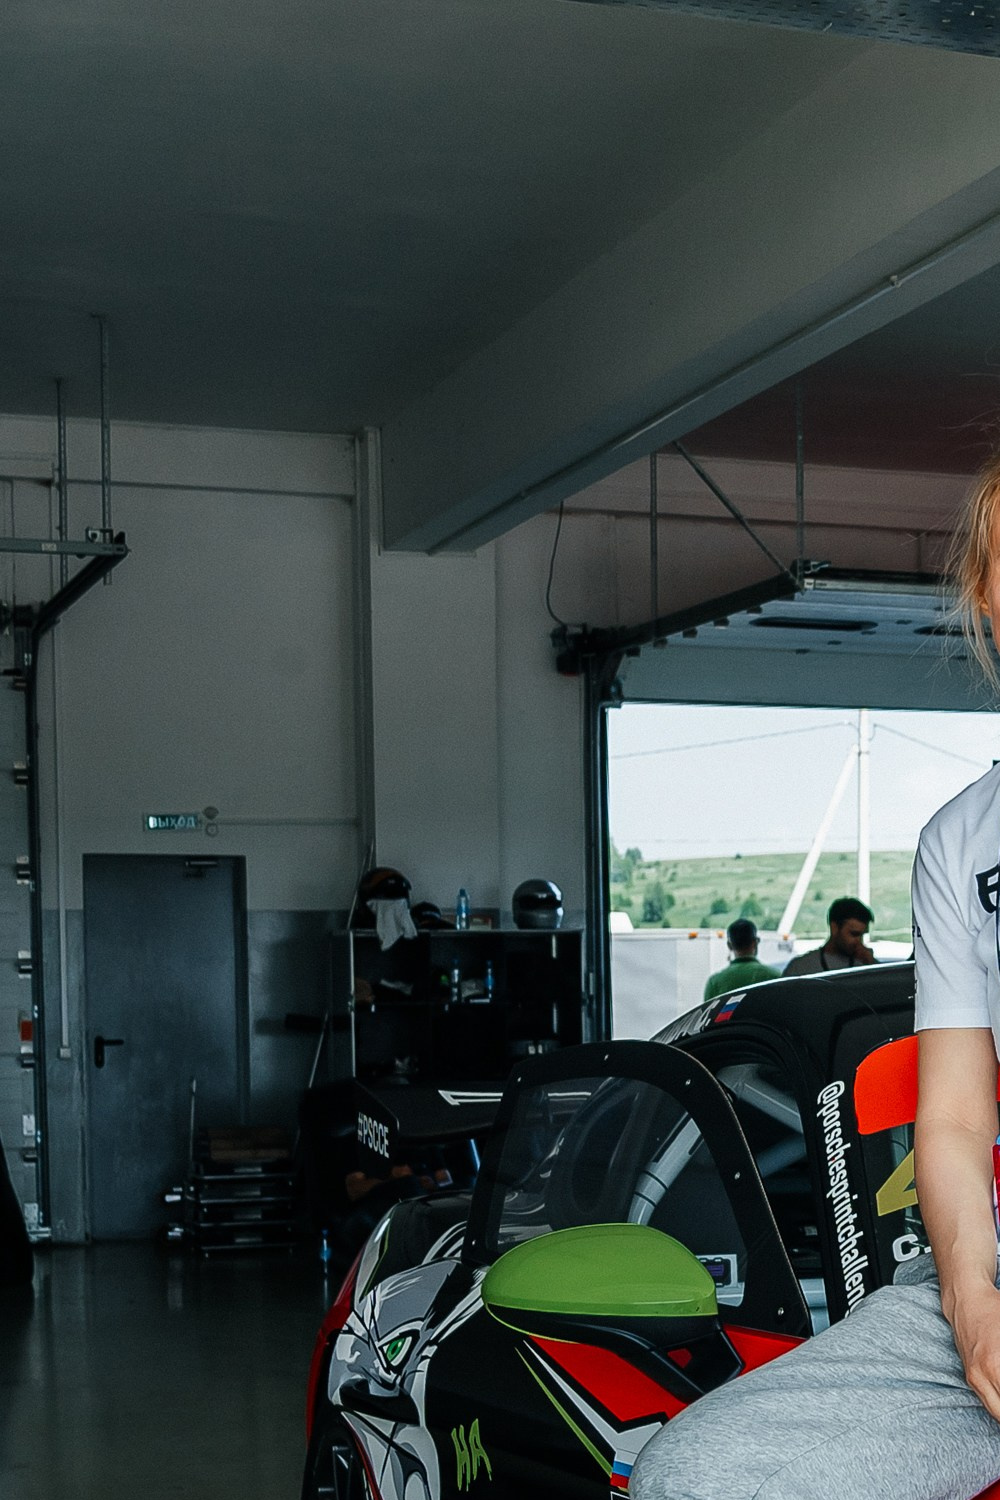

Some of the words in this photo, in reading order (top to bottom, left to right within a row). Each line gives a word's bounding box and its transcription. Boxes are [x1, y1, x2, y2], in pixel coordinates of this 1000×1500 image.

[148, 815, 196, 830] ВЫХОД
[357, 1112, 390, 1158] #PSCCE
[451, 1418, 493, 1492] HA
